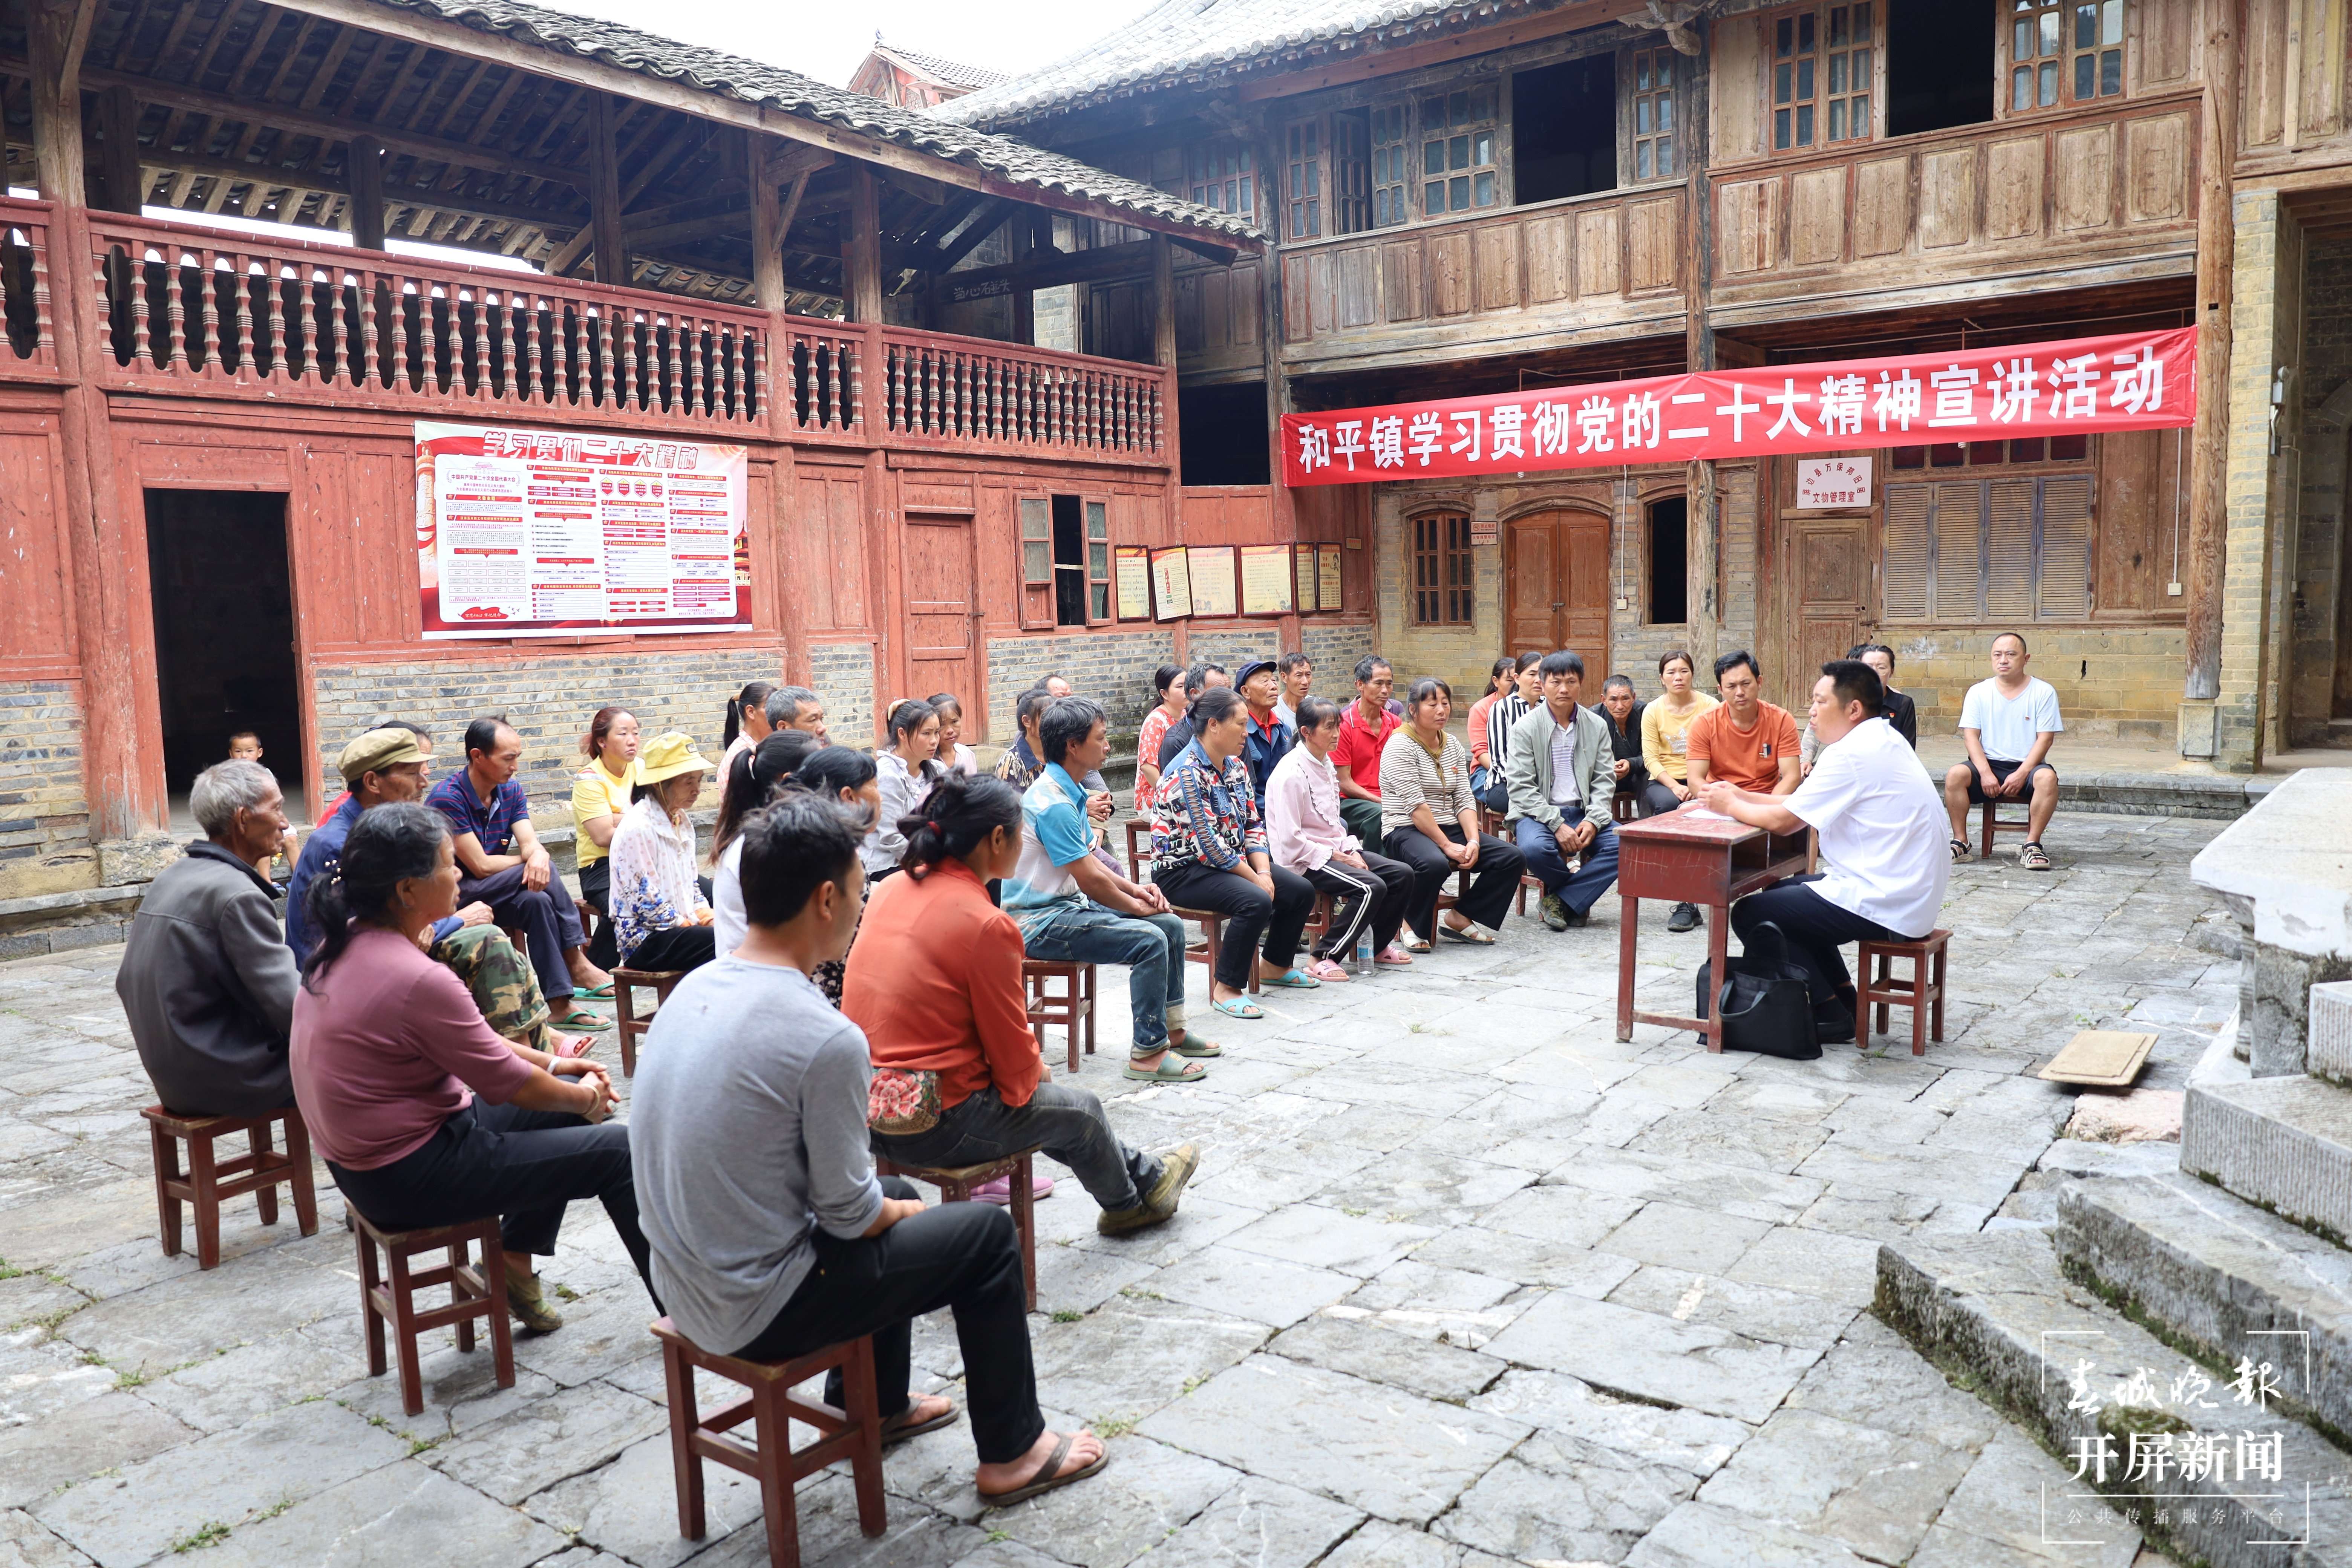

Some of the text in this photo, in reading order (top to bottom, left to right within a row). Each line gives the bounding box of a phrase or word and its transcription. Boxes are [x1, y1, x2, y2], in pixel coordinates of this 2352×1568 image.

[953, 279, 1011, 300] 当心碰头
[1298, 346, 2164, 473] 和平镇学习贯彻党的二十大精神宣讲活动
[482, 431, 699, 470] 学习贯彻二十大精神
[1813, 491, 1855, 504] 文物管理室
